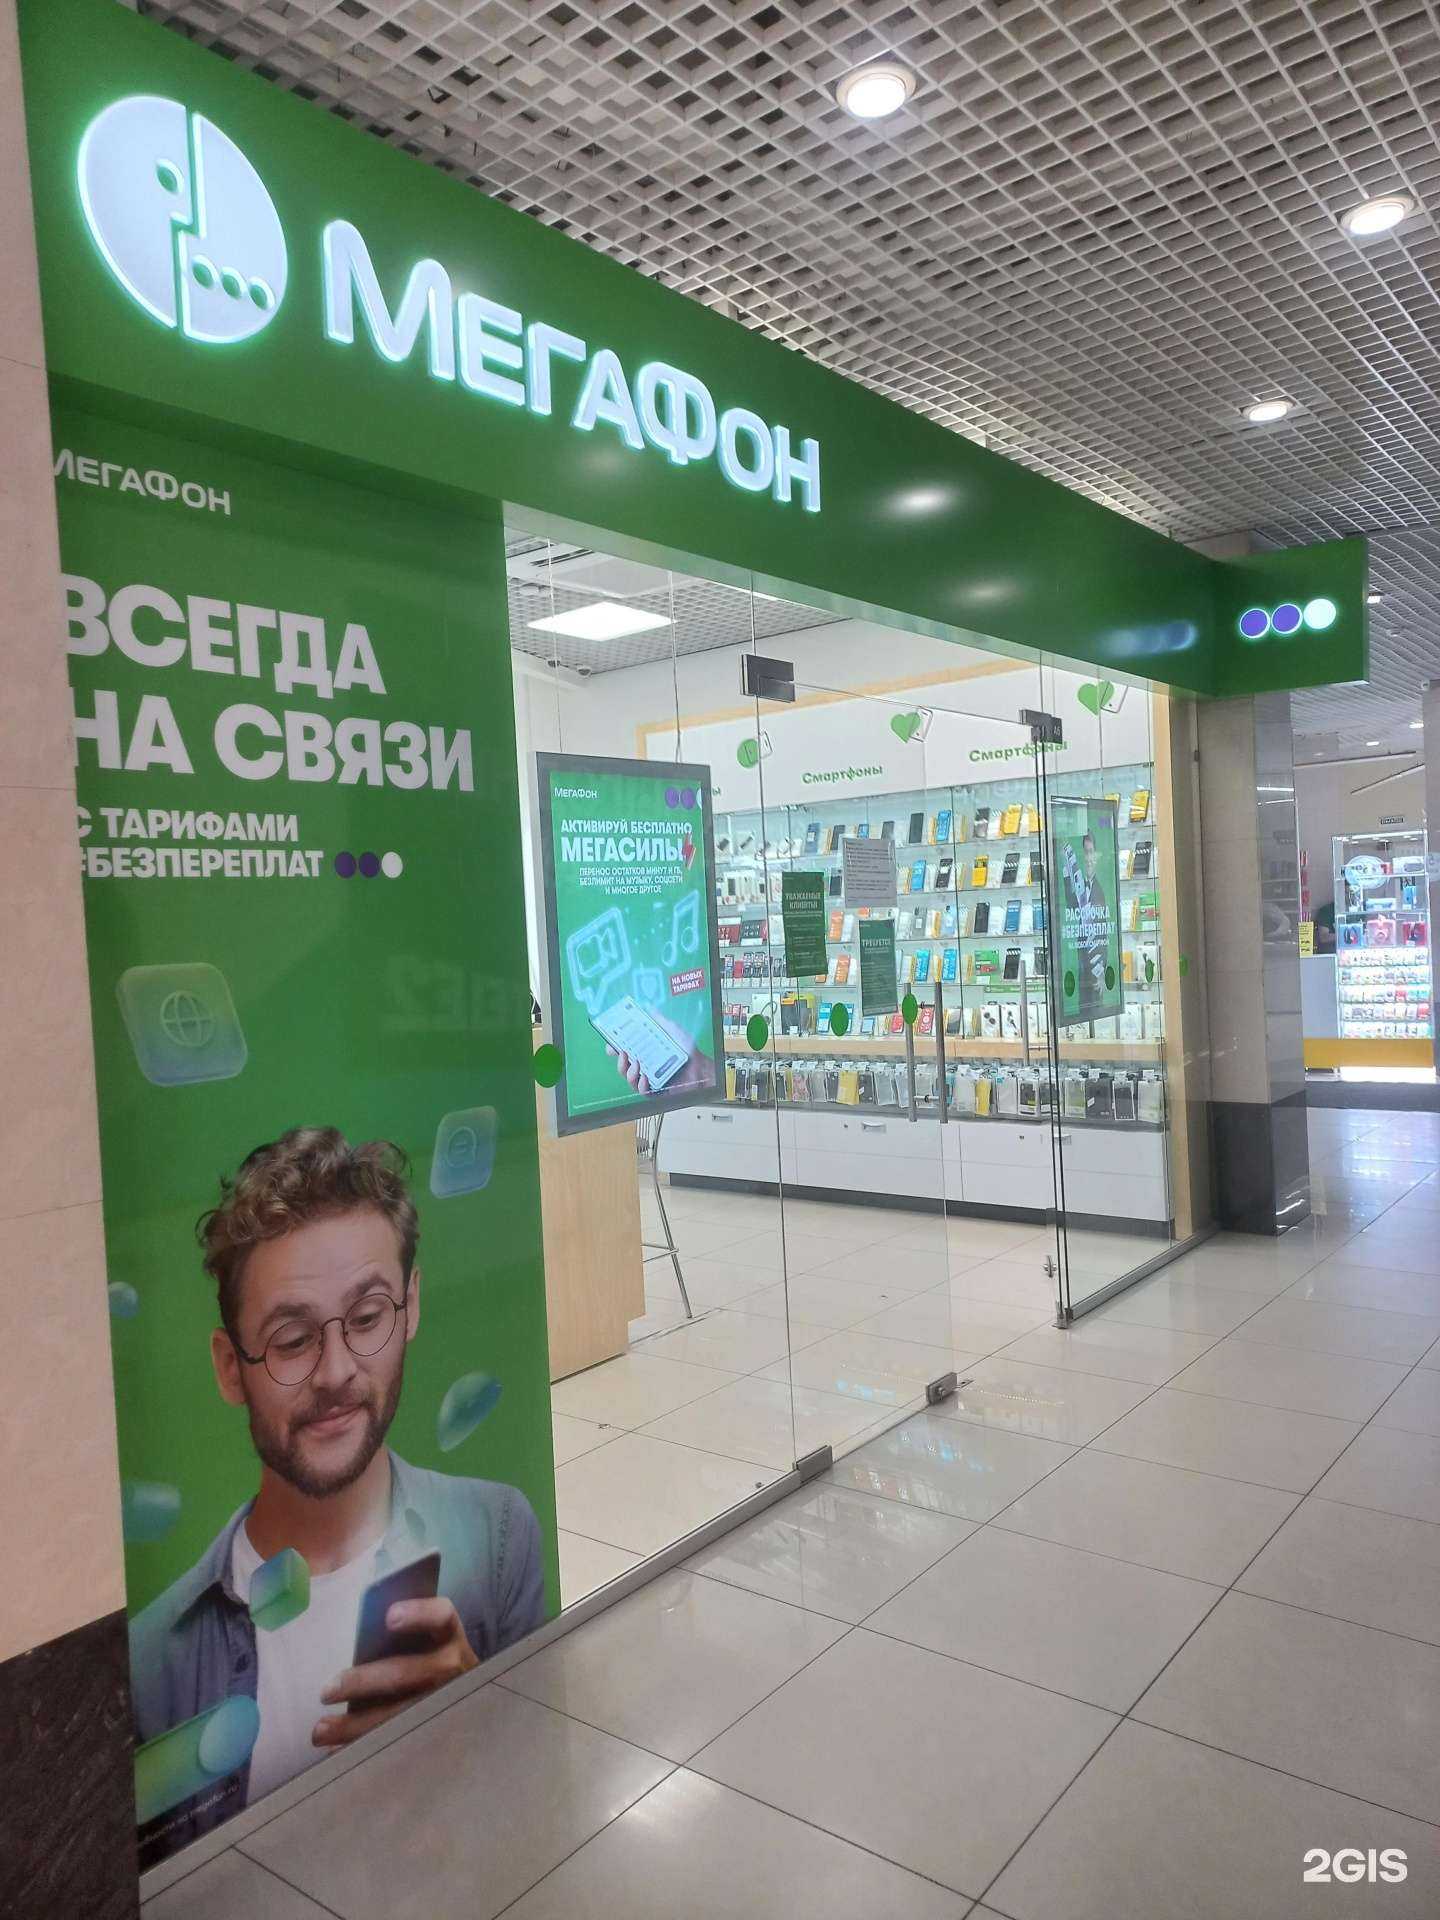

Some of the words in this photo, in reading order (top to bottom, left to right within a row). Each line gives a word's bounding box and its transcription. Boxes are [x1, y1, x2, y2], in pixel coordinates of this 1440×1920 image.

[61, 573, 387, 699] ВСЕГДА
[68, 686, 194, 774] НА
[213, 702, 475, 792] СВЯЗИ
[802, 766, 883, 785] Смартфоны
[99, 807, 299, 842] ТАРИФАМИ
[560, 818, 628, 834] АКТИВИРУЙ
[630, 820, 693, 835] БЕСПЛАТНО
[560, 836, 684, 863] МЕГАСИЛЫ
